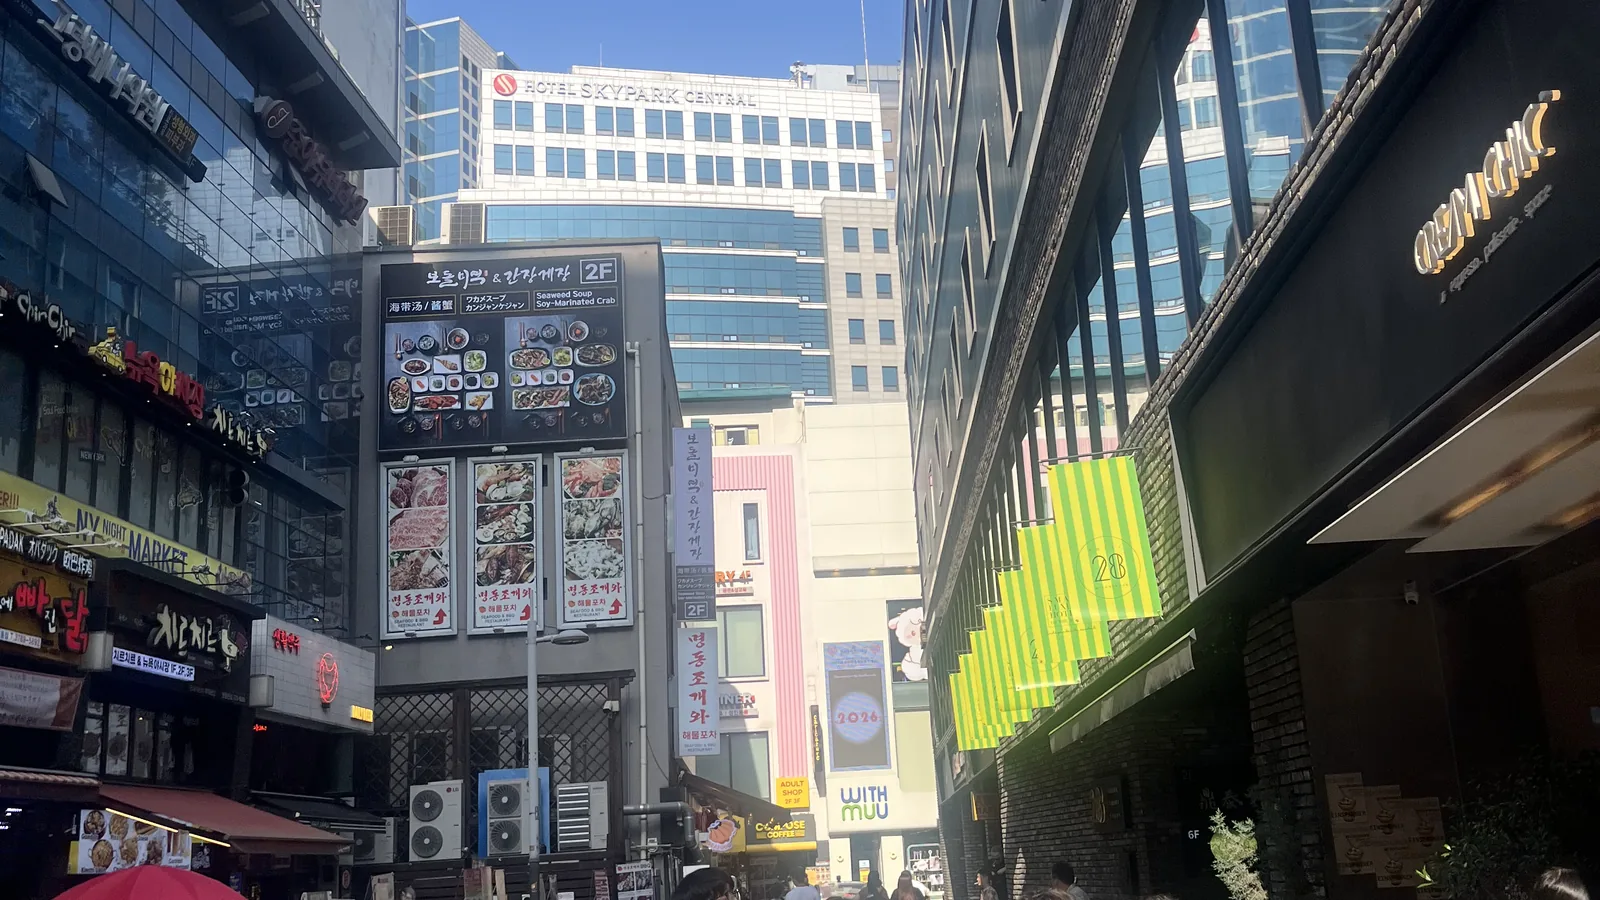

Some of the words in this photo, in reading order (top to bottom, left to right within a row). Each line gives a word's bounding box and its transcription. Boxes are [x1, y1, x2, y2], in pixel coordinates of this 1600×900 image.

[525, 80, 576, 96] HOTEL
[580, 83, 680, 105] SKYPARK
[685, 91, 757, 107] CENTRAL
[493, 273, 502, 283] &
[504, 265, 571, 285] 간장게장
[585, 262, 613, 281] 2F
[466, 294, 507, 304] ワカメスープ
[536, 290, 571, 299] Seaweed
[573, 290, 593, 299] Soup
[465, 301, 525, 311] カンジャンケジャン
[536, 298, 595, 308] Soy-Marinated
[597, 296, 616, 305] Crab
[690, 495, 698, 505] &
[688, 507, 702, 561] 간장게장
[76, 508, 100, 543] NY
[102, 519, 127, 542] NIGHT
[128, 530, 188, 578] MARKET
[1091, 553, 1126, 583] 28
[567, 583, 622, 597] 명동조개와
[391, 592, 447, 606] 명동조개와
[577, 598, 606, 608] 해물포차
[401, 608, 430, 617] 해물포차
[487, 603, 517, 613] 해물포차
[687, 604, 705, 617] 2F
[60, 587, 90, 654] 닭
[154, 603, 217, 655] 치르치르
[137, 656, 142, 666] &
[143, 657, 170, 673] 뉴욕야시장
[688, 632, 710, 725] 명동조개와
[837, 712, 878, 725] 2026
[682, 731, 717, 740] 해물포차
[840, 785, 888, 803] WITH
[767, 830, 795, 839] COFFEE
[1187, 829, 1200, 840] 6F
